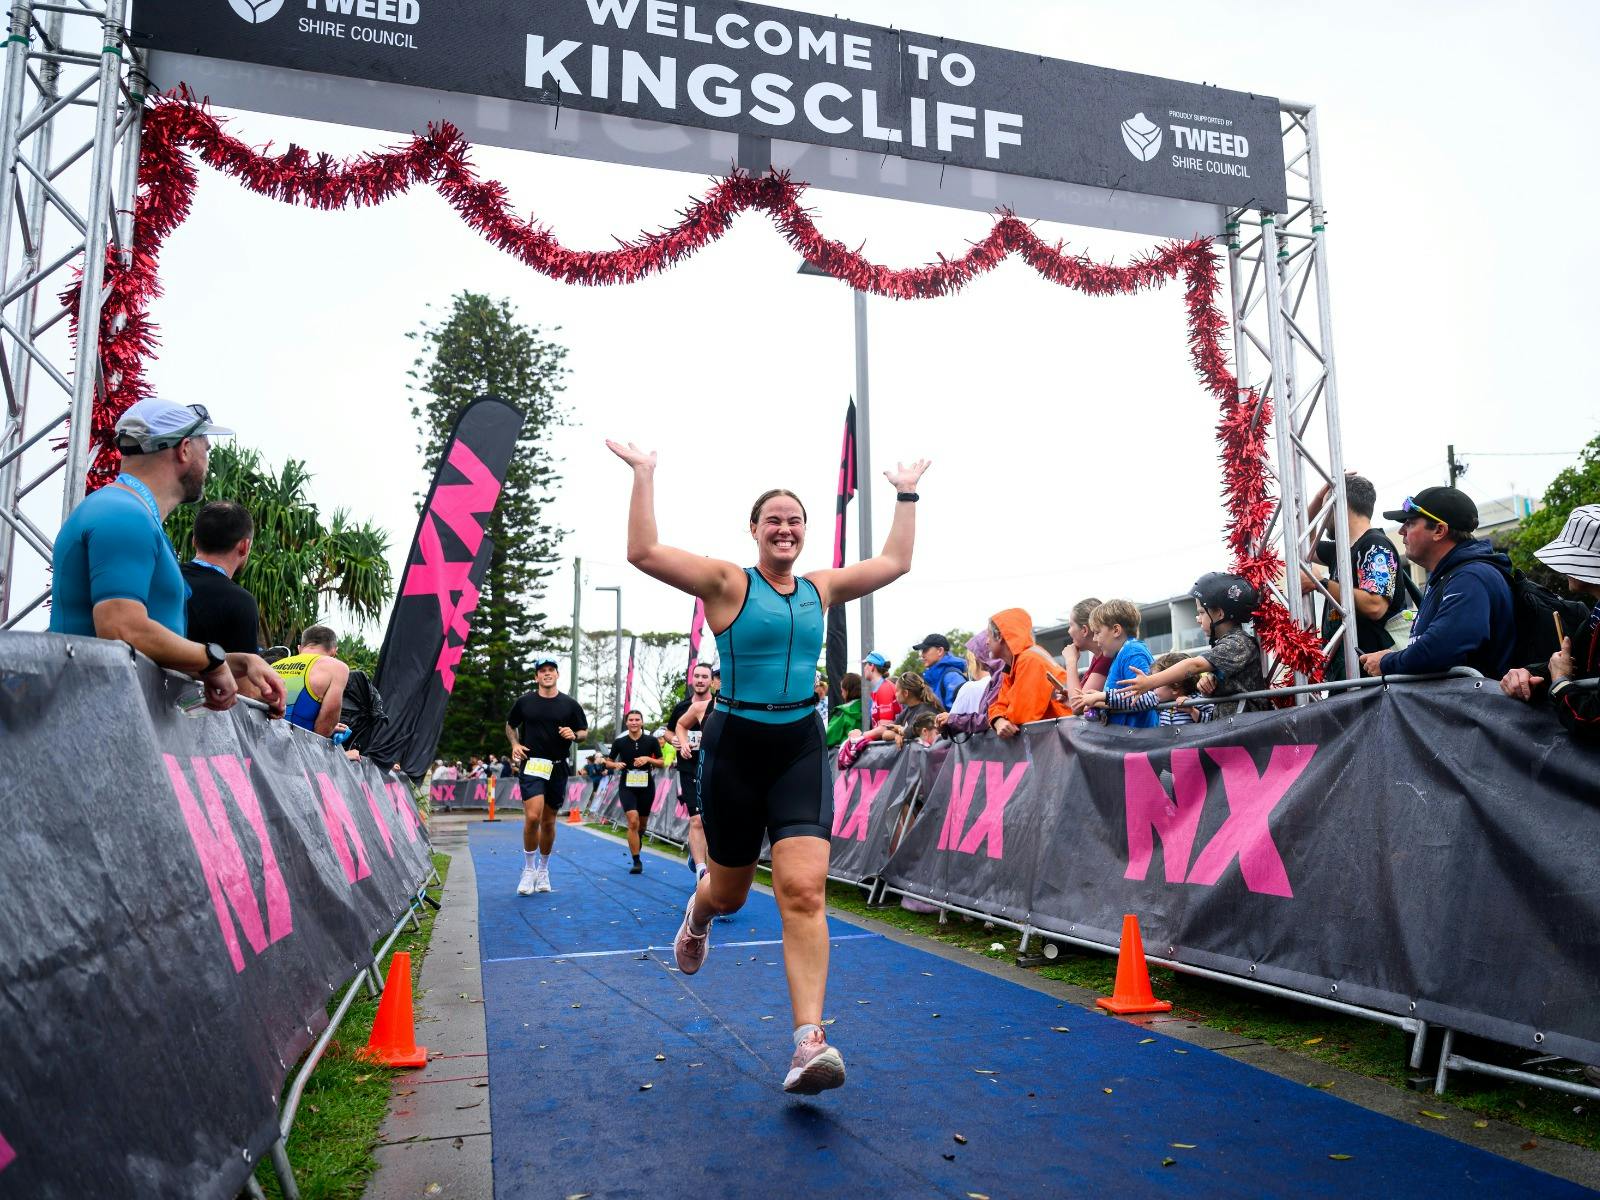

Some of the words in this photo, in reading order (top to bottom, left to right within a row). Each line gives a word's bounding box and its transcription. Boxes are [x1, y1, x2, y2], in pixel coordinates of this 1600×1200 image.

[299, 17, 346, 38] SHIRE
[351, 26, 418, 49] COUNCIL
[585, 0, 872, 71] WELCOME
[908, 45, 976, 87] TO
[524, 33, 1024, 159] KINGSCLIFF
[1169, 110, 1193, 120] PROUDLY
[1193, 114, 1225, 126] SUPPORTED
[1225, 119, 1233, 127] BY
[1169, 124, 1249, 158] TWEED
[1172, 154, 1204, 171] SHIRE
[1206, 160, 1251, 179] COUNCIL
[430, 784, 456, 801] NX
[831, 768, 891, 842] NX
[937, 760, 1030, 860] NX
[1124, 744, 1319, 898] NX
